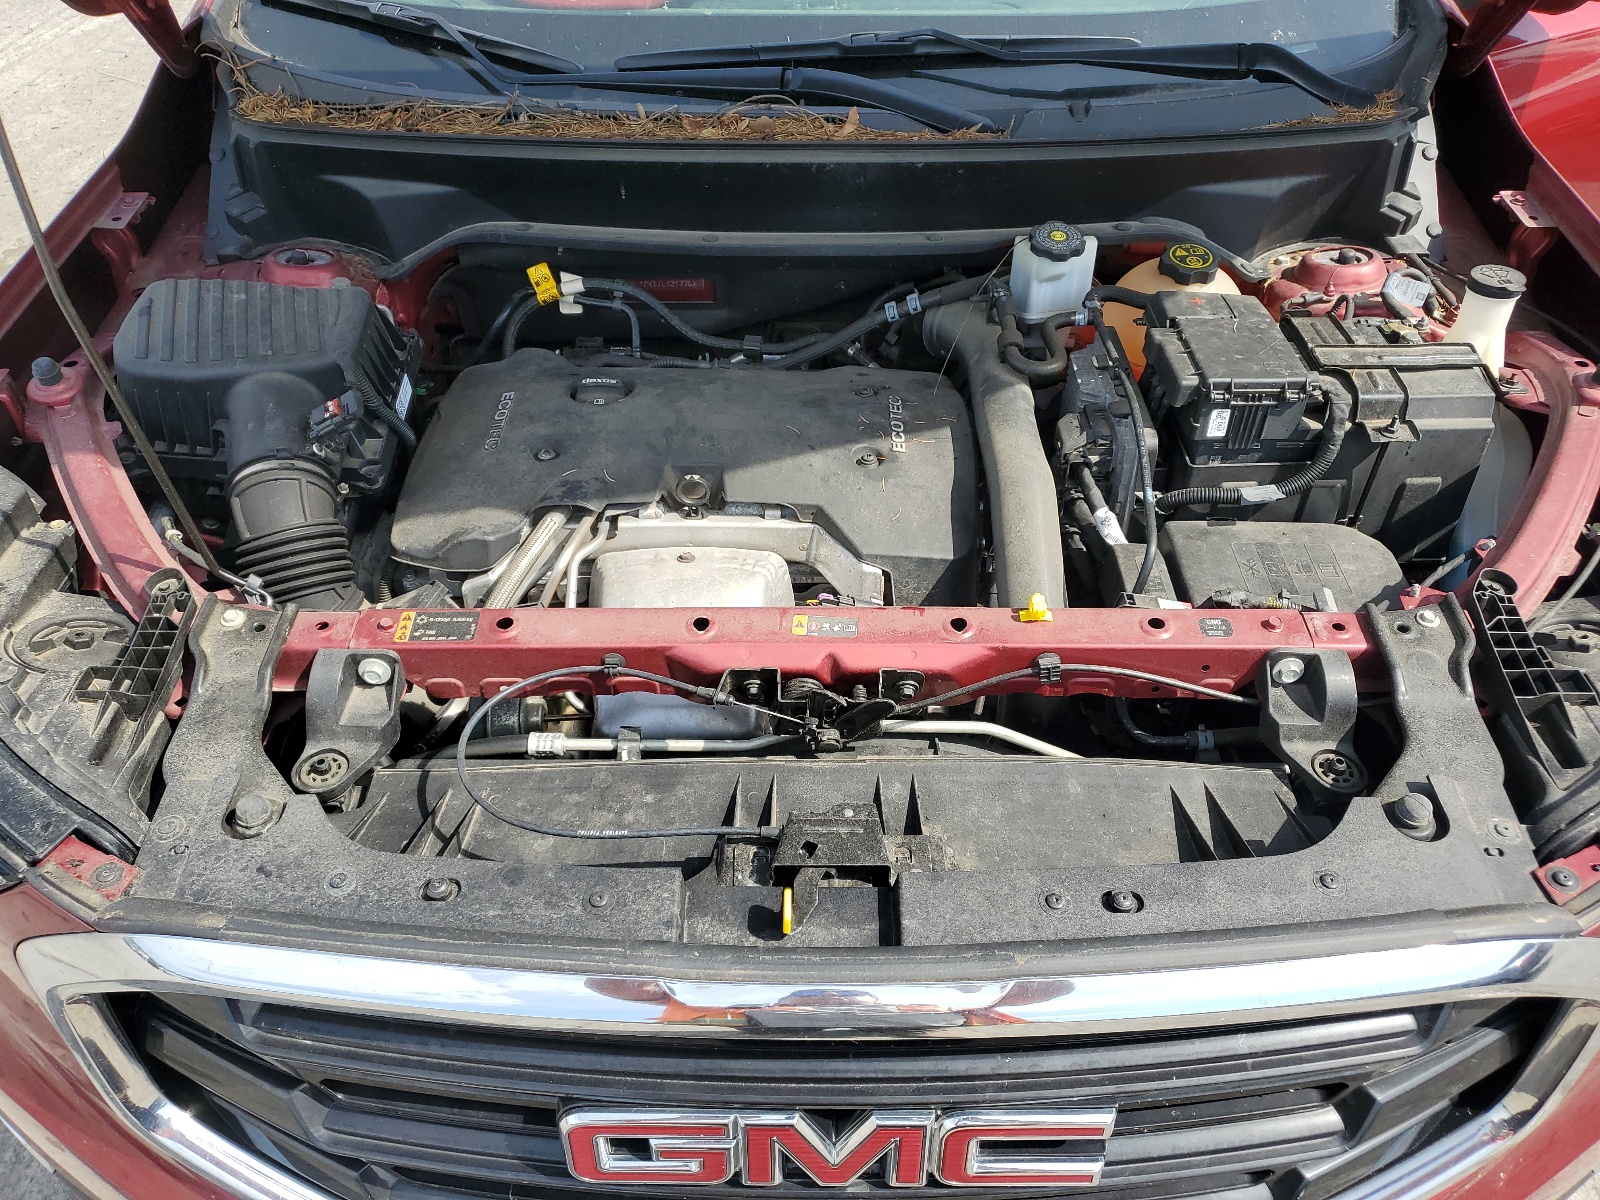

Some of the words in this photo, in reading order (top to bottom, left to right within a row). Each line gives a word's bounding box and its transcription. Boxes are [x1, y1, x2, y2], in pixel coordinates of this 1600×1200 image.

[484, 391, 514, 450] ECOTEC
[888, 395, 906, 452] ECOTEC
[559, 1106, 1118, 1188] GMC
